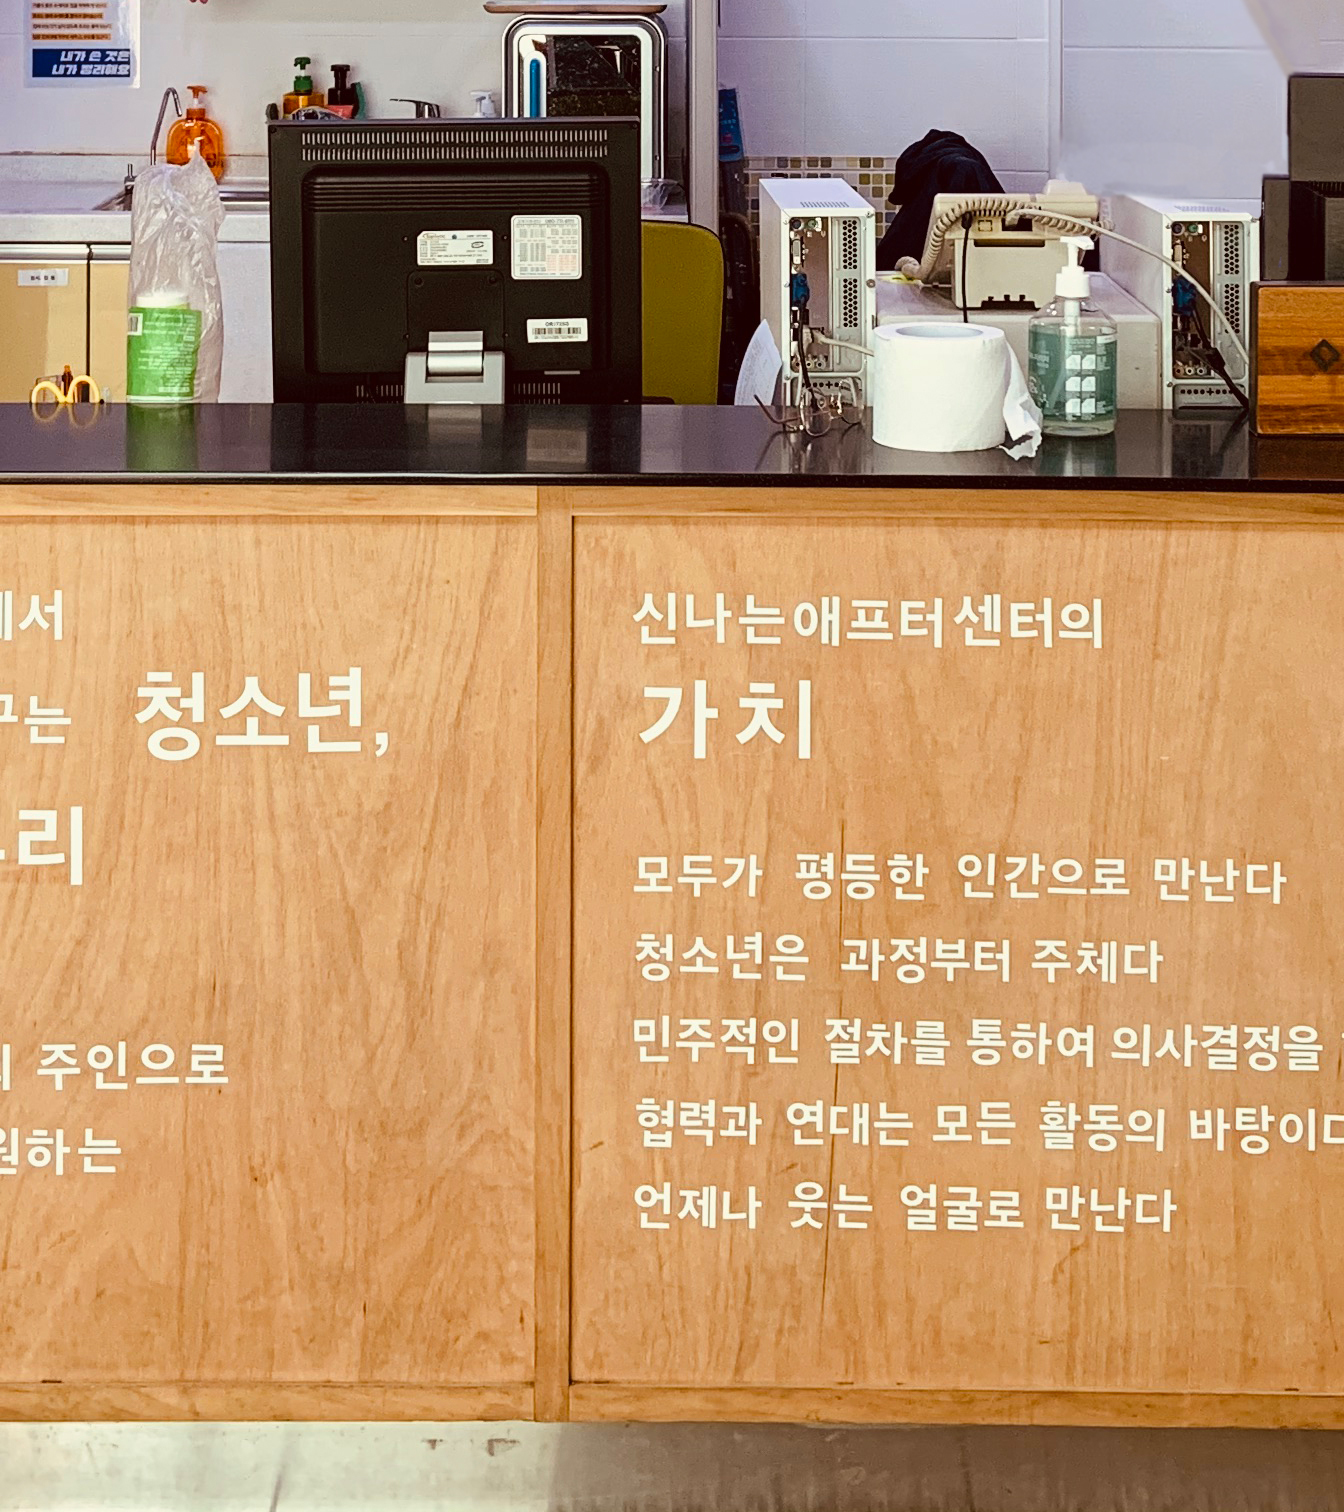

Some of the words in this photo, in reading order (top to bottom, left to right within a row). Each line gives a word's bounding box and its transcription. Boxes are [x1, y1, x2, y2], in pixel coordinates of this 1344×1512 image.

[51, 64, 78, 75] 내가
[60, 51, 86, 62] 내가
[633, 592, 1102, 649] 신나는애프터센터의
[135, 667, 388, 761] 청소년,
[640, 679, 811, 759] 가치
[633, 855, 763, 897] 모두가
[796, 853, 929, 900] 평등한
[958, 853, 1129, 899] 인간으로
[1154, 858, 1287, 904] 만난다
[636, 932, 809, 981] 청소년은
[841, 937, 1010, 984] 과정부터
[1031, 940, 1164, 984] 주체다
[37, 1041, 229, 1091] 주인으로
[634, 1015, 798, 1065] 민주적인
[825, 1019, 950, 1066] 절차를
[967, 1019, 1094, 1067] 통하여
[1111, 1024, 1323, 1071] 의사결정을
[636, 1098, 762, 1148] 협력과
[786, 1100, 913, 1146] 연대는
[933, 1102, 1016, 1145] 모든
[1039, 1101, 1165, 1152] 활동의
[634, 1182, 762, 1229] 언제나
[788, 1181, 873, 1229] 웃는
[900, 1184, 1024, 1231] 얼굴로
[1046, 1185, 1177, 1232] 만난다
